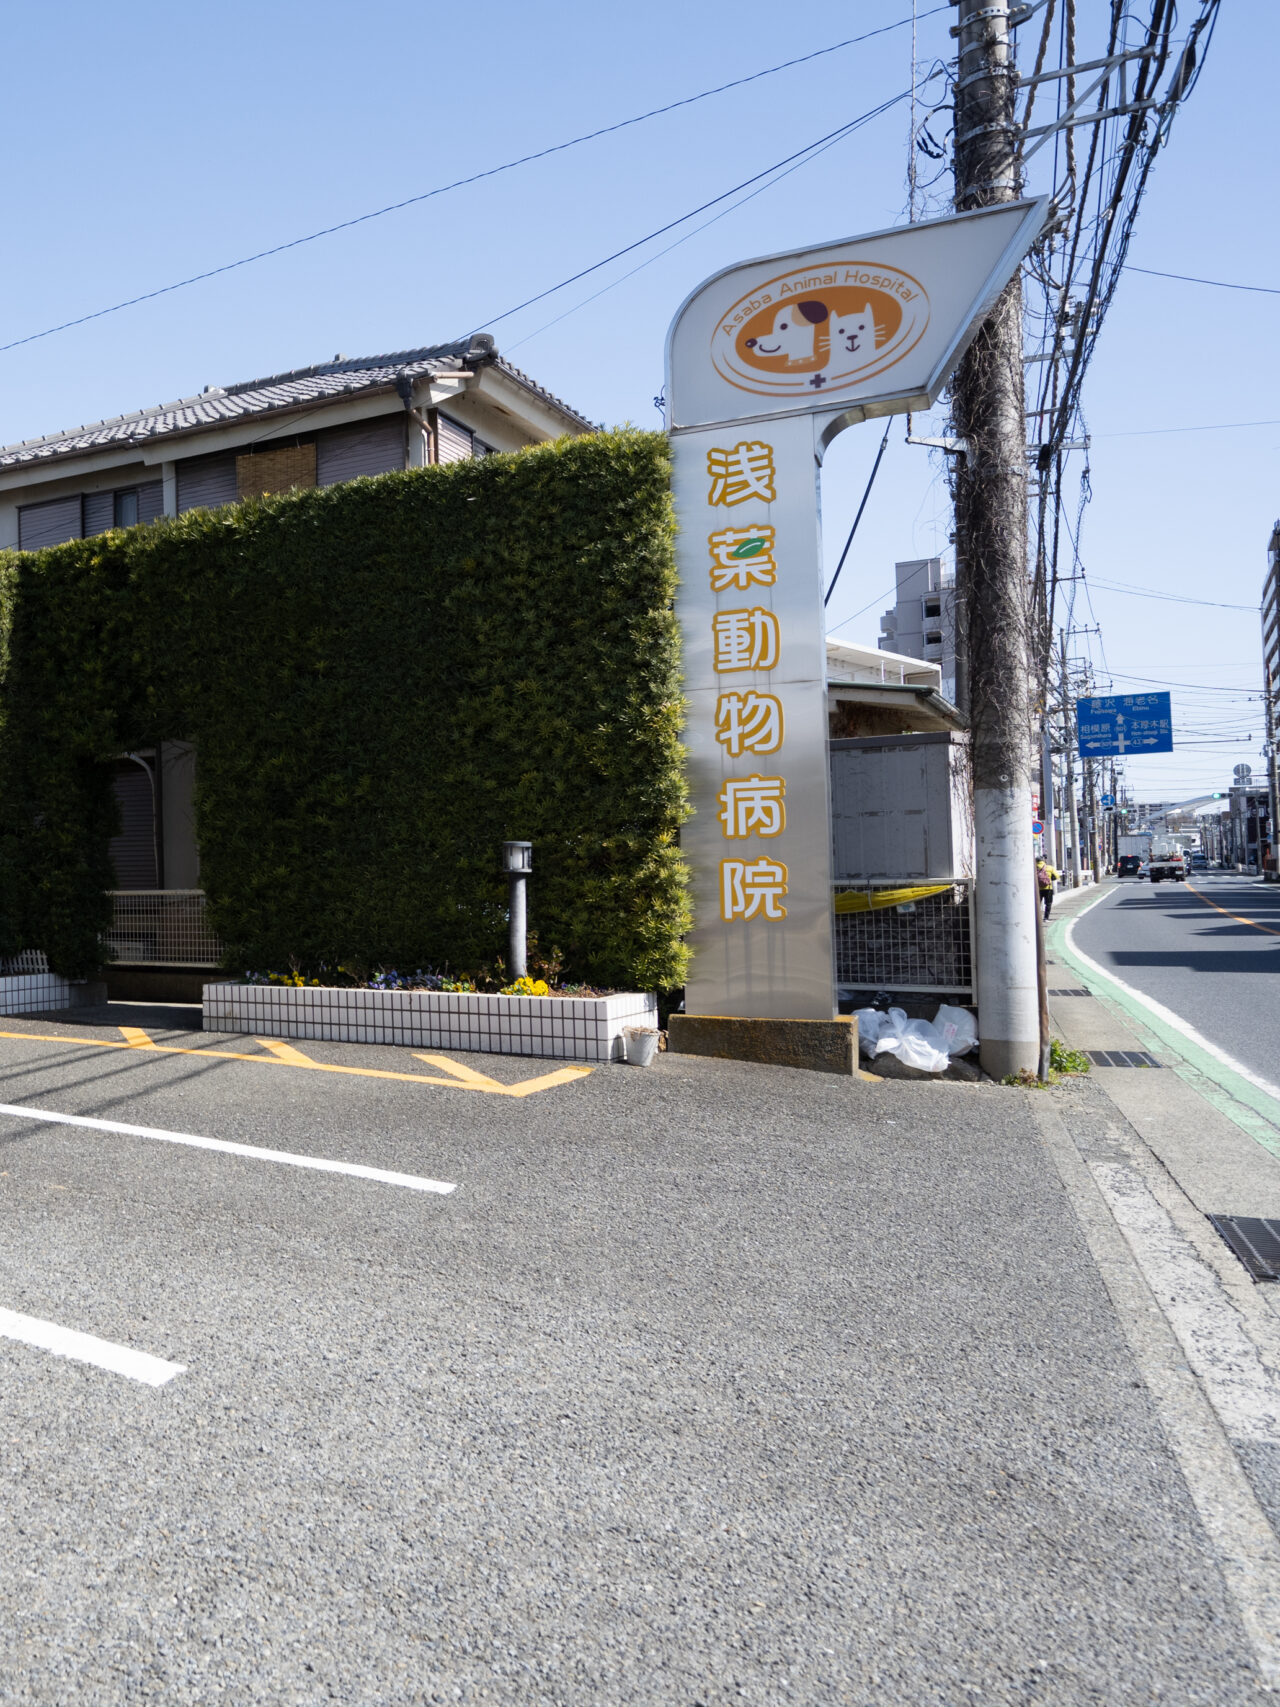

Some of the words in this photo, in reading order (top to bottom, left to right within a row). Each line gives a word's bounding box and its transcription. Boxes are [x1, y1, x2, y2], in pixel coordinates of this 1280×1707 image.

[721, 292, 773, 337] Asaba
[779, 271, 838, 297] Animal
[844, 269, 920, 304] Hospital
[706, 439, 788, 923] 浅葉動物病院
